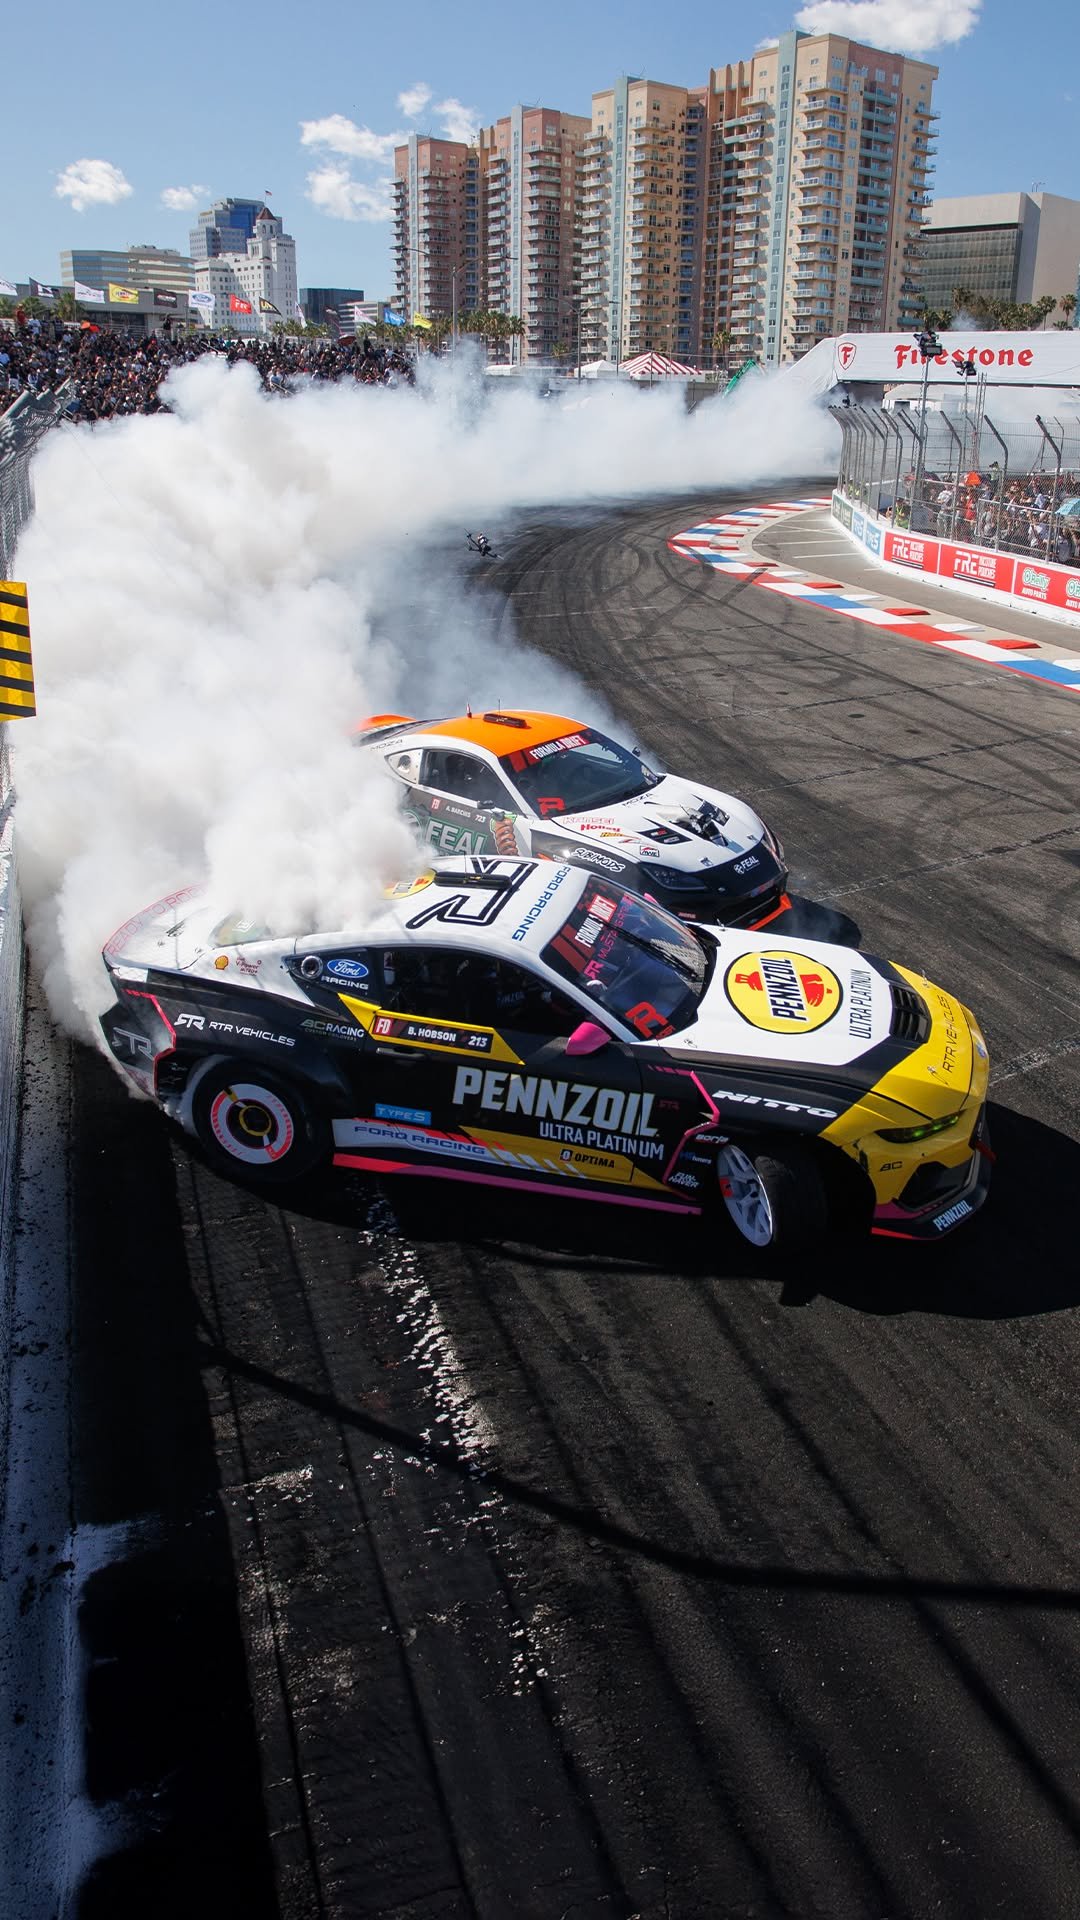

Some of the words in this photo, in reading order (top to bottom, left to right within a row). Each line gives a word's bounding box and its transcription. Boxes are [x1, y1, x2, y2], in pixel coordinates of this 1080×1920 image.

[953, 550, 979, 575] FRE
[529, 741, 567, 760] FORMULA
[559, 734, 587, 749] DRIFT
[741, 856, 759, 870] FEAL
[547, 865, 572, 895] FORD
[511, 889, 553, 942] RACING
[588, 894, 617, 922] DRIFT
[321, 975, 369, 990] RACING
[333, 960, 361, 977] Ford
[760, 957, 808, 1021] PENNZOIL
[849, 968, 873, 1007] PLATINUM
[375, 1018, 391, 1034] FD
[848, 1005, 872, 1040] ULTRA
[937, 994, 958, 1045] VEHICLES
[208, 1021, 234, 1033] RTR
[234, 1025, 297, 1047] VEHICLES
[408, 1026, 417, 1036] B.
[418, 1028, 457, 1042] HOBSON
[468, 1035, 487, 1048] 213
[942, 1046, 958, 1074] RTR
[452, 1065, 659, 1138] PENNZOIL
[711, 1089, 838, 1119] NITTO
[353, 1125, 408, 1140] FORD
[411, 1135, 486, 1154] RACING
[539, 1121, 585, 1145] ULTRA
[586, 1130, 665, 1161] PLATINUM
[574, 1153, 615, 1169] OPTIMA
[932, 1199, 973, 1232] PENNZOIL
